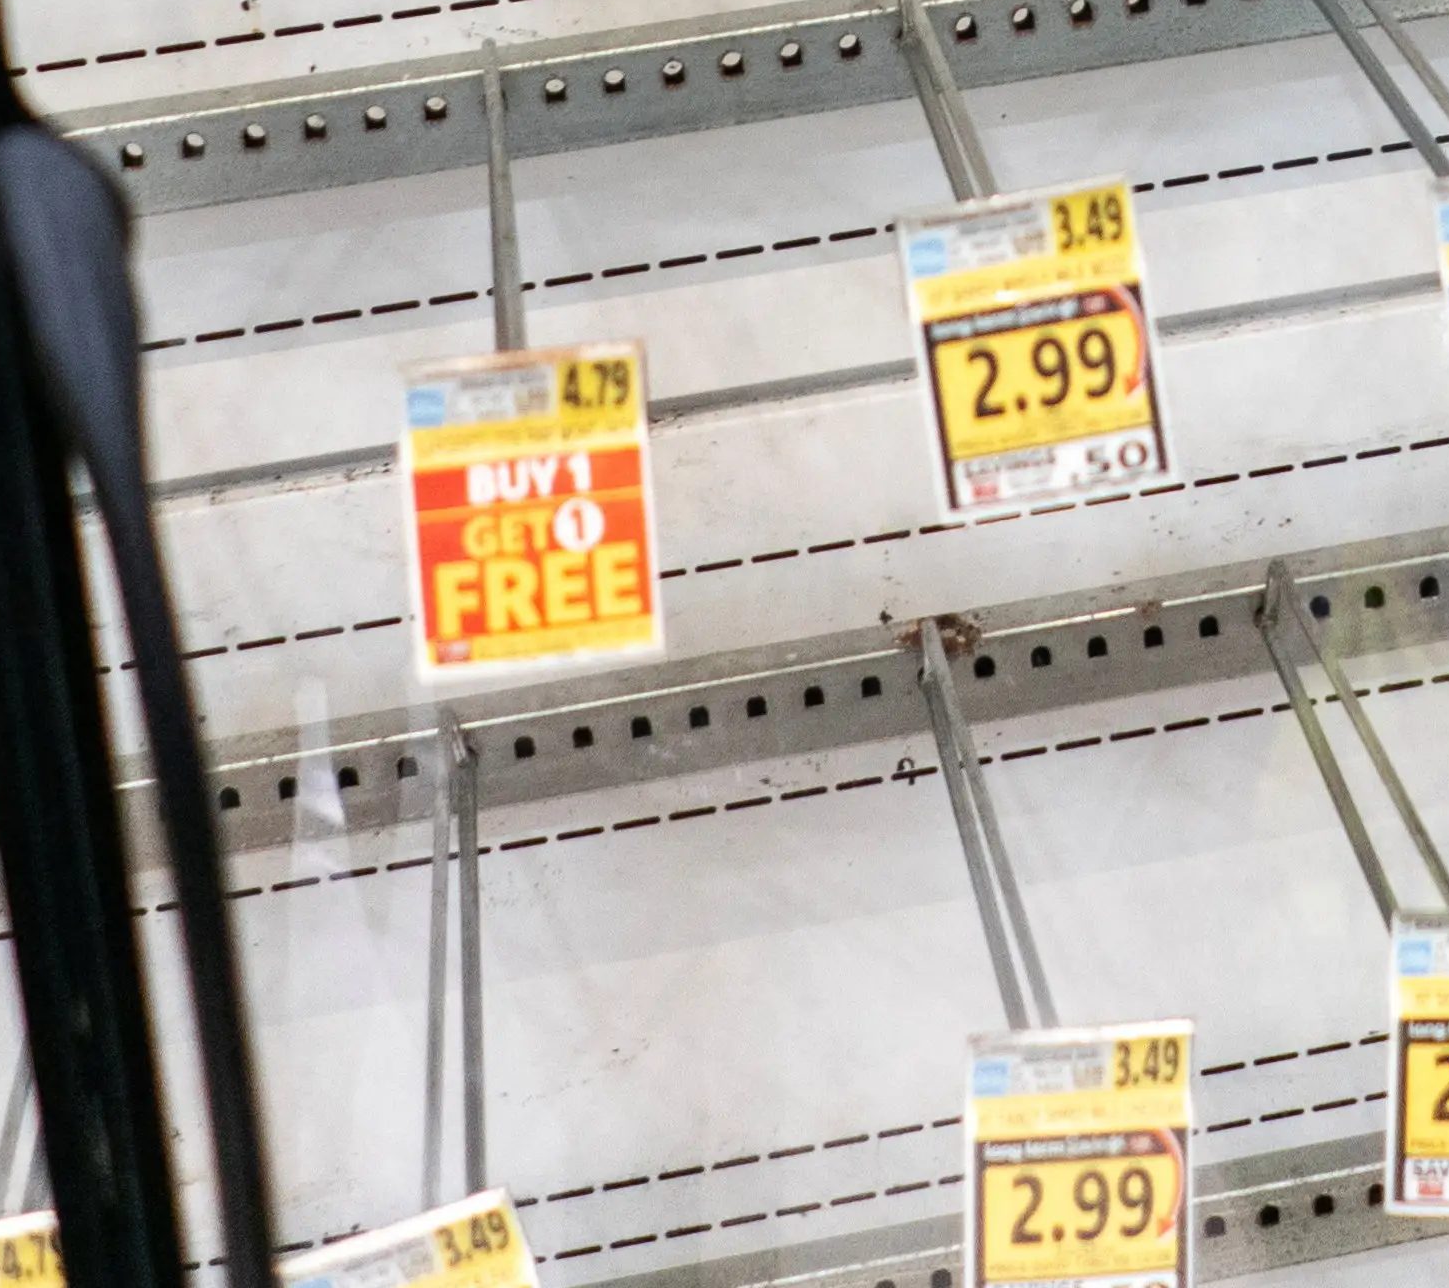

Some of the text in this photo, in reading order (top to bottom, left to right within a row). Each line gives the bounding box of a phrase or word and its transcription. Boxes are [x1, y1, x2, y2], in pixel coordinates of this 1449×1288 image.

[1055, 193, 1124, 250] 3.49
[563, 359, 631, 409] 4.79
[967, 327, 1116, 419] 2.99
[467, 452, 592, 505] BUY 1
[462, 508, 552, 559] GET
[432, 540, 644, 639] FREE
[1115, 1036, 1180, 1090] 3.49
[1010, 1167, 1155, 1245] 2.99
[439, 1209, 512, 1269] 3.49
